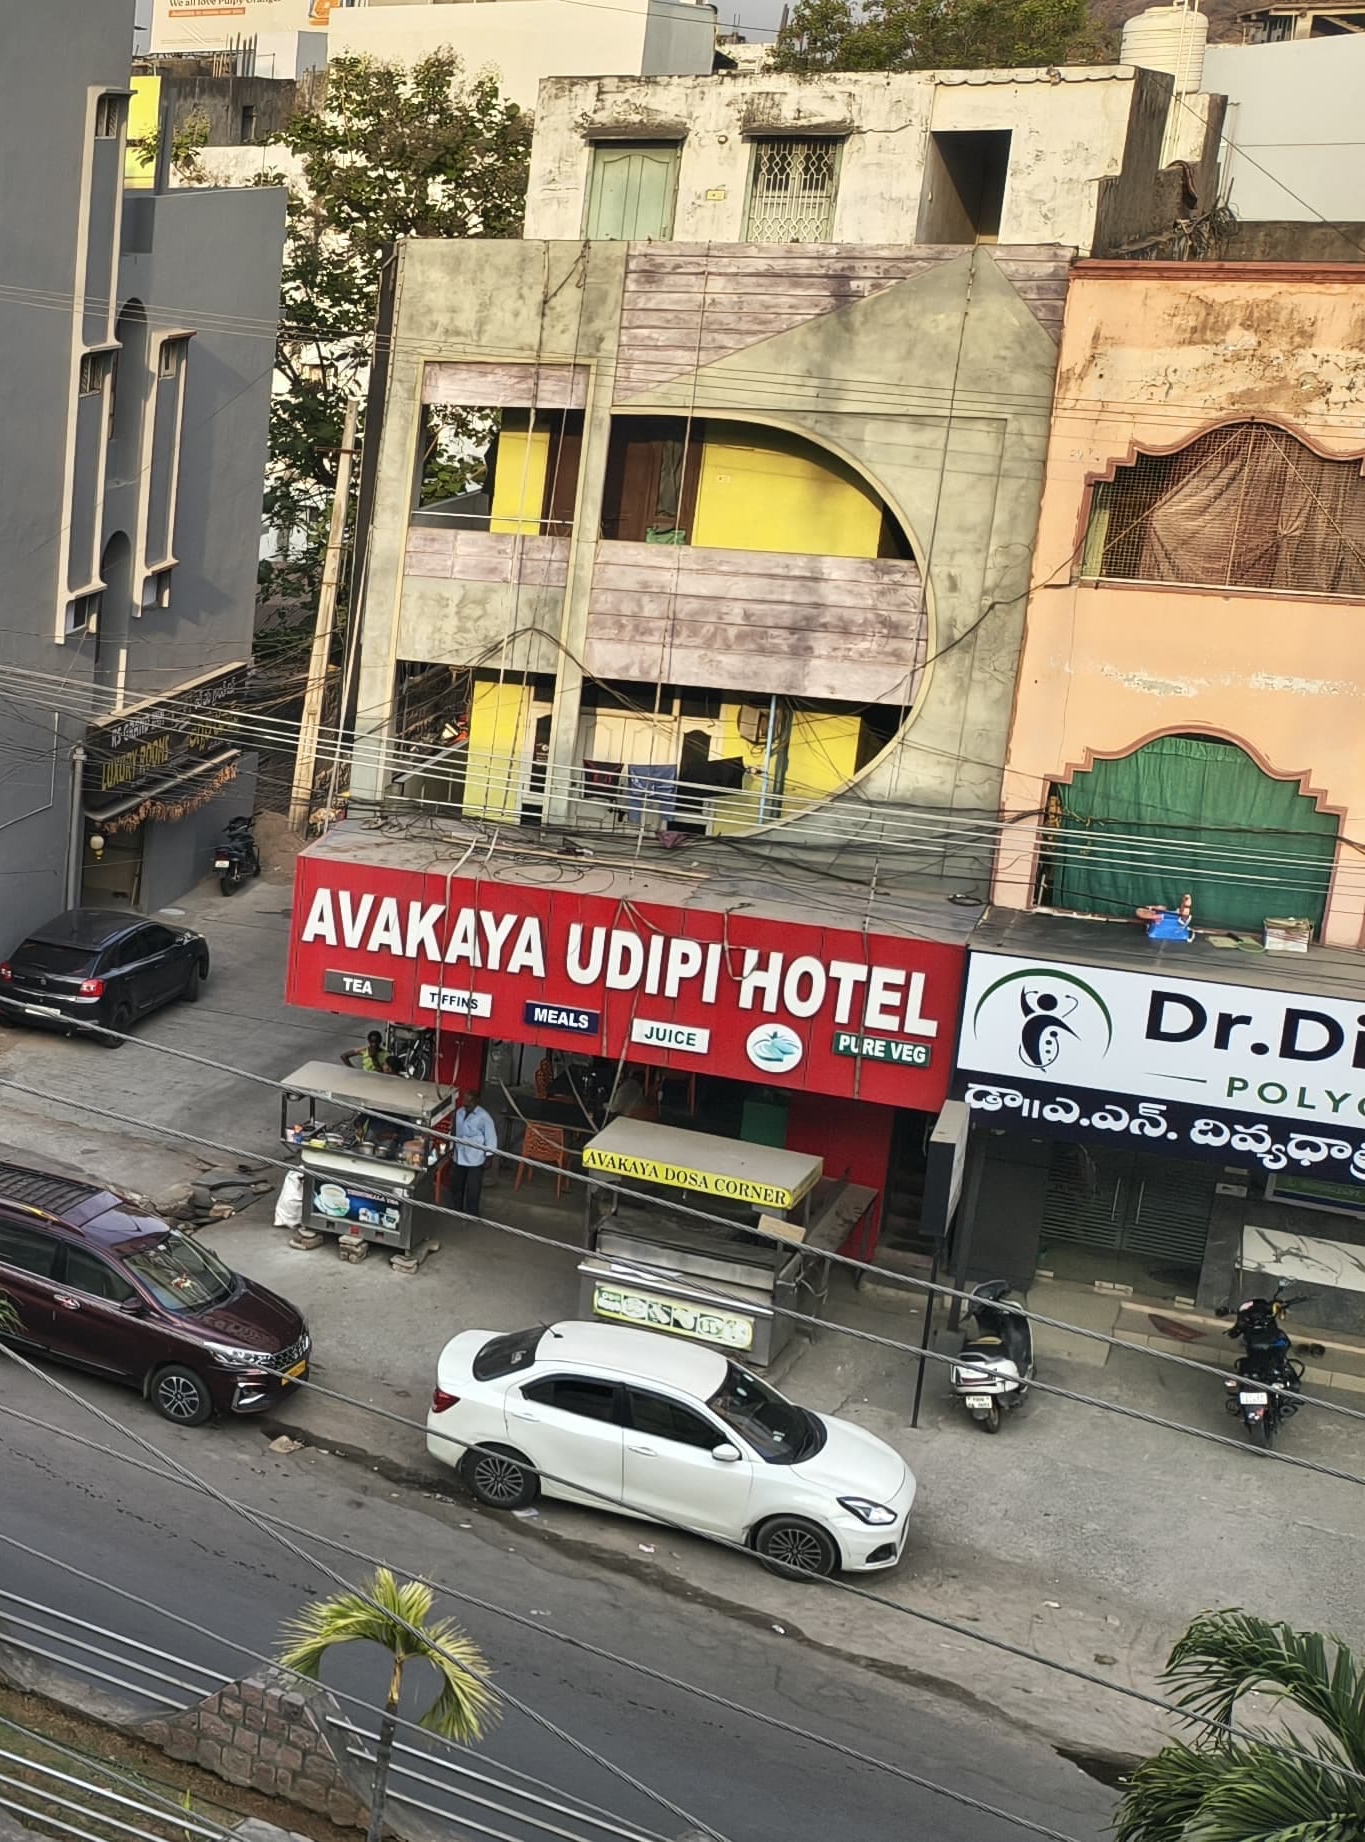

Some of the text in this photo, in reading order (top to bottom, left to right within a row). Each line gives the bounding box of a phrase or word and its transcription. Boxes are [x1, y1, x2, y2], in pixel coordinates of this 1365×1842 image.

[301, 886, 939, 1039] AVAKAYA UDIPI HOTEL
[342, 976, 373, 996] TEA
[428, 991, 481, 1012] TIFFINS
[533, 1006, 590, 1030] MEALS
[643, 1025, 697, 1049] JUICE
[838, 1034, 926, 1063] PURE VEG
[1226, 1076, 1365, 1117] POLY
[585, 1151, 787, 1205] AVAKAYA DOSA CORNER
